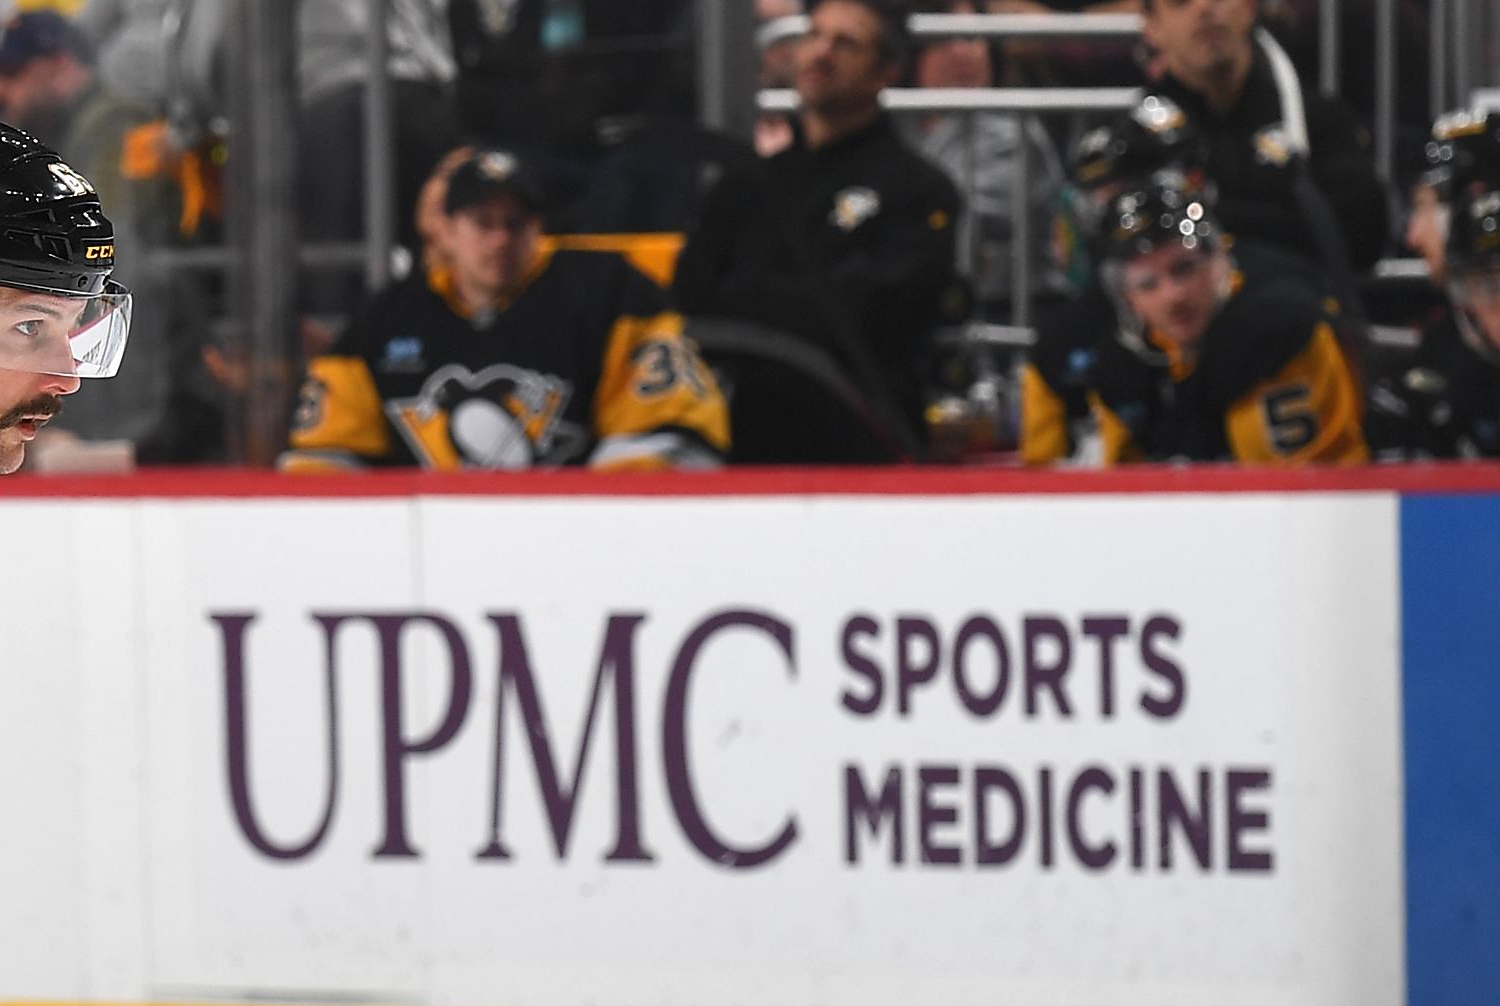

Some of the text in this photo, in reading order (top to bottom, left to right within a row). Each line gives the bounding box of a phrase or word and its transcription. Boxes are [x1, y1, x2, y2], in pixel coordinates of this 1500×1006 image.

[1265, 384, 1317, 452] 5
[838, 612, 1188, 721] SPORTS
[208, 606, 800, 872] UPMC
[842, 763, 1276, 874] MEDICINE
